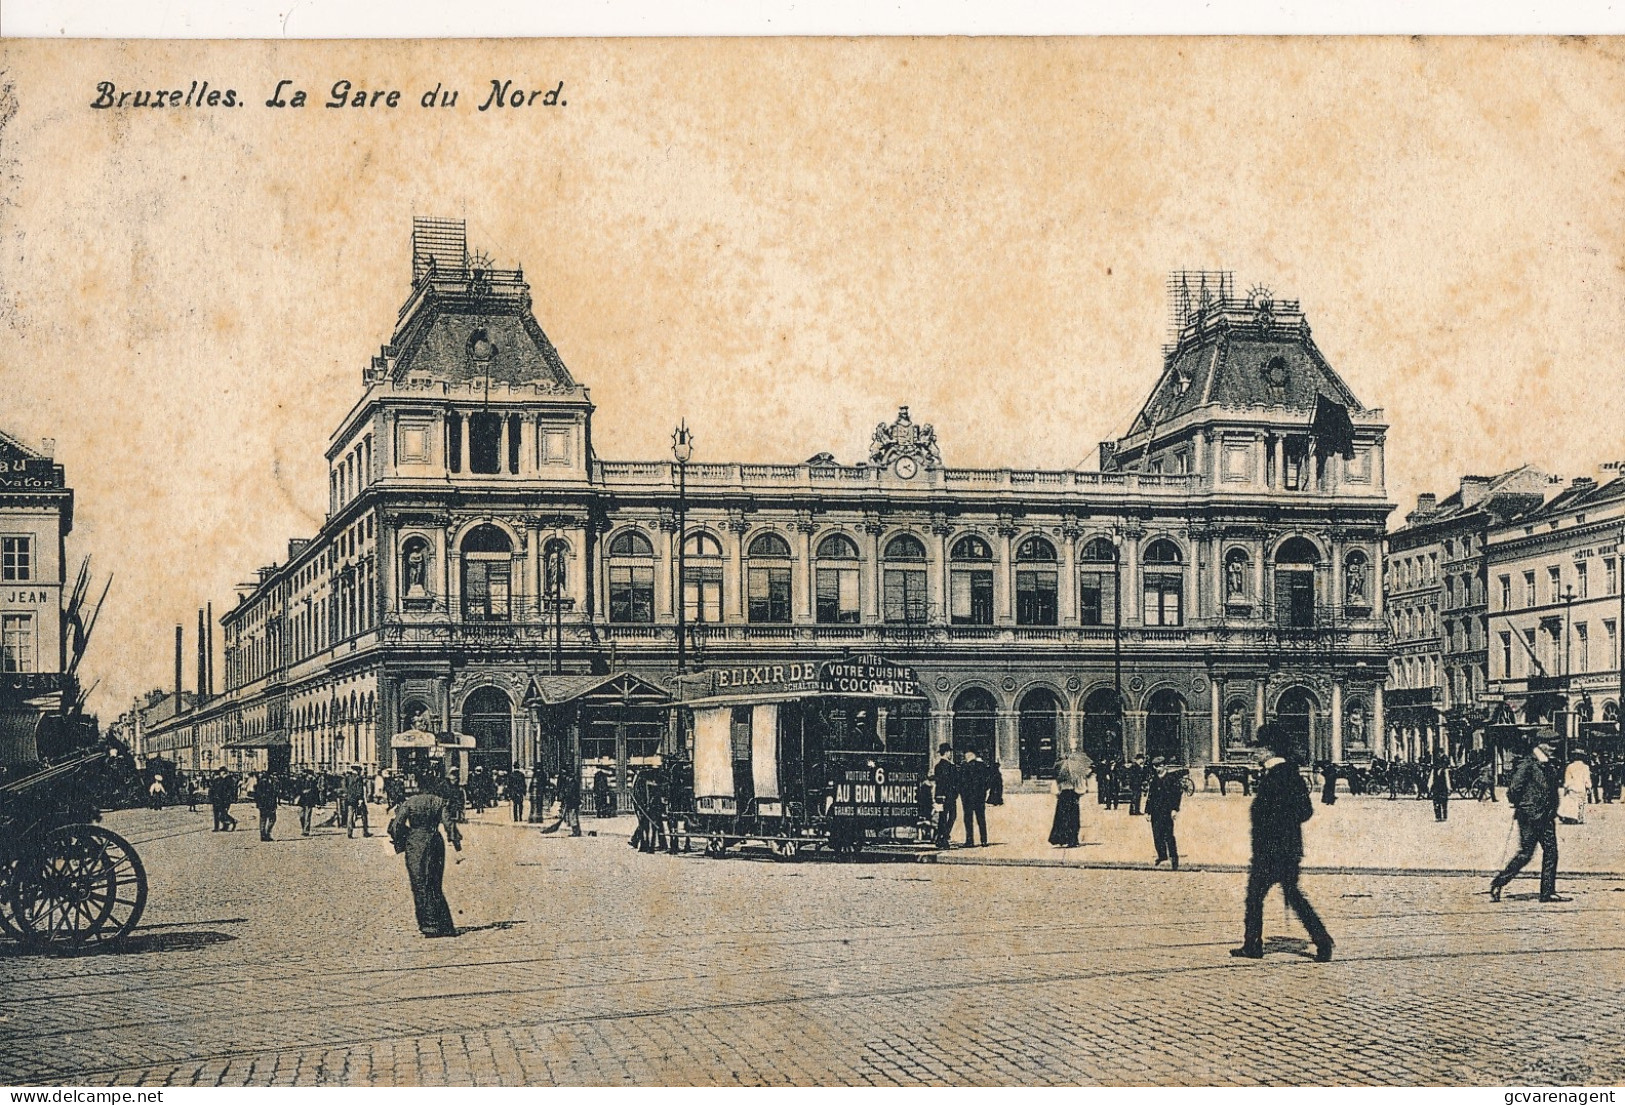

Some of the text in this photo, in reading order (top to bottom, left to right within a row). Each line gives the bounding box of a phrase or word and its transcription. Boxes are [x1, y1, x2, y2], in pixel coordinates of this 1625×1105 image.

[8, 591, 48, 604] JEAN
[858, 654, 883, 665] FAITES
[719, 663, 815, 687] ELIXIR DE
[828, 664, 911, 680] VOTRE CUISINE
[875, 767, 885, 785] 6
[836, 784, 850, 803] AU
[855, 784, 876, 803] BON
